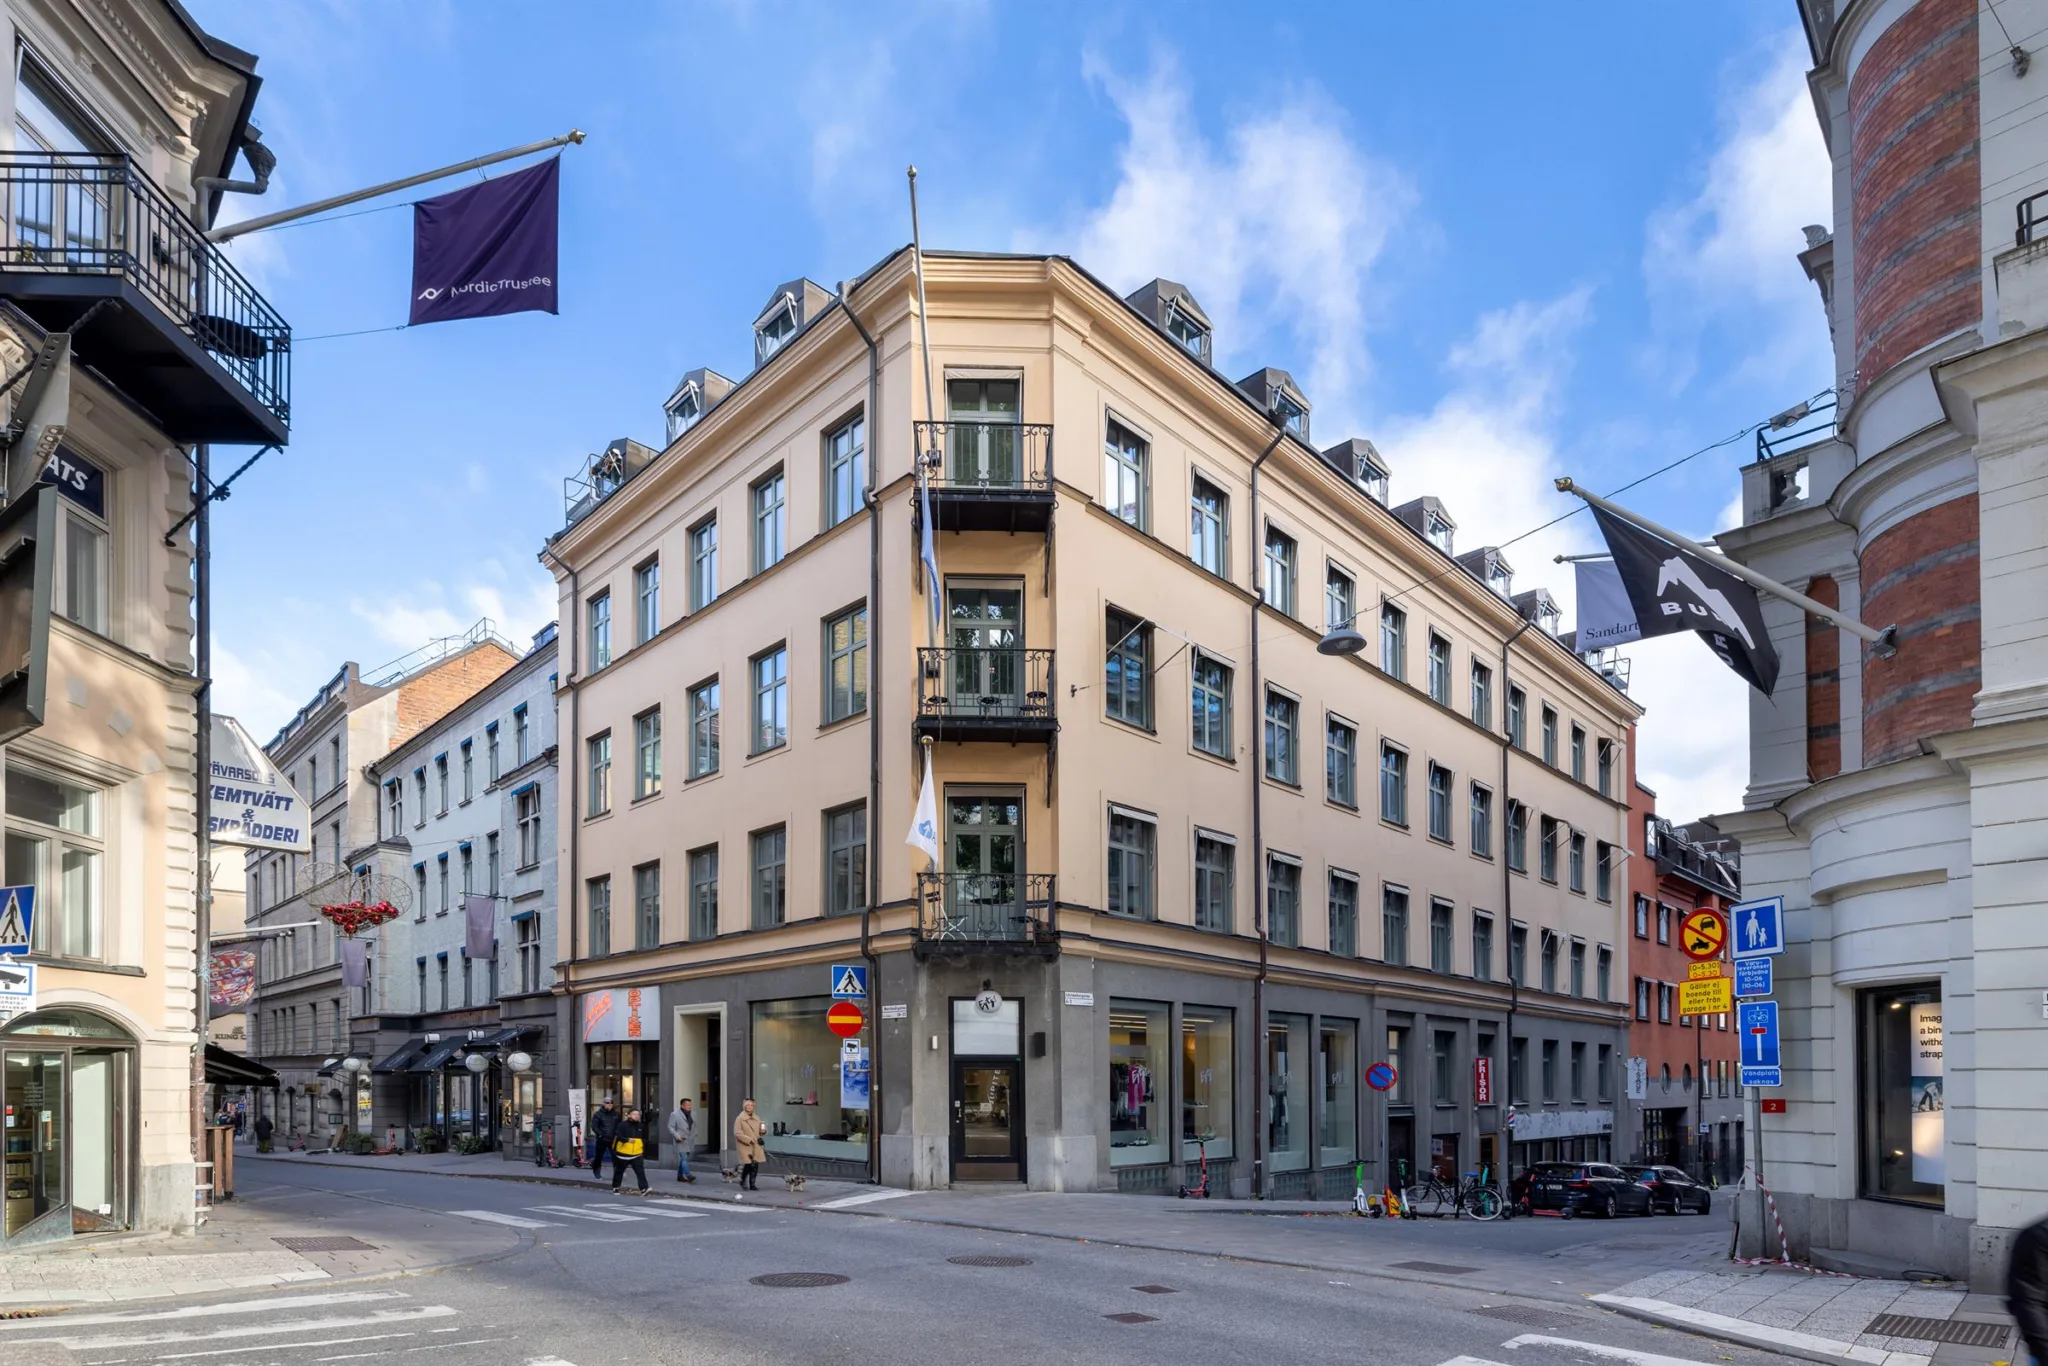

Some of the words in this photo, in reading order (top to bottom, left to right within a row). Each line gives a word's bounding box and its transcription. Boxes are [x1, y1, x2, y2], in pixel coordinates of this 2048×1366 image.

[241, 808, 255, 820] &
[1712, 981, 1720, 989] ej
[1685, 990, 1711, 998] boende
[1682, 1005, 1707, 1013] garage
[1927, 1026, 1942, 1034] bin
